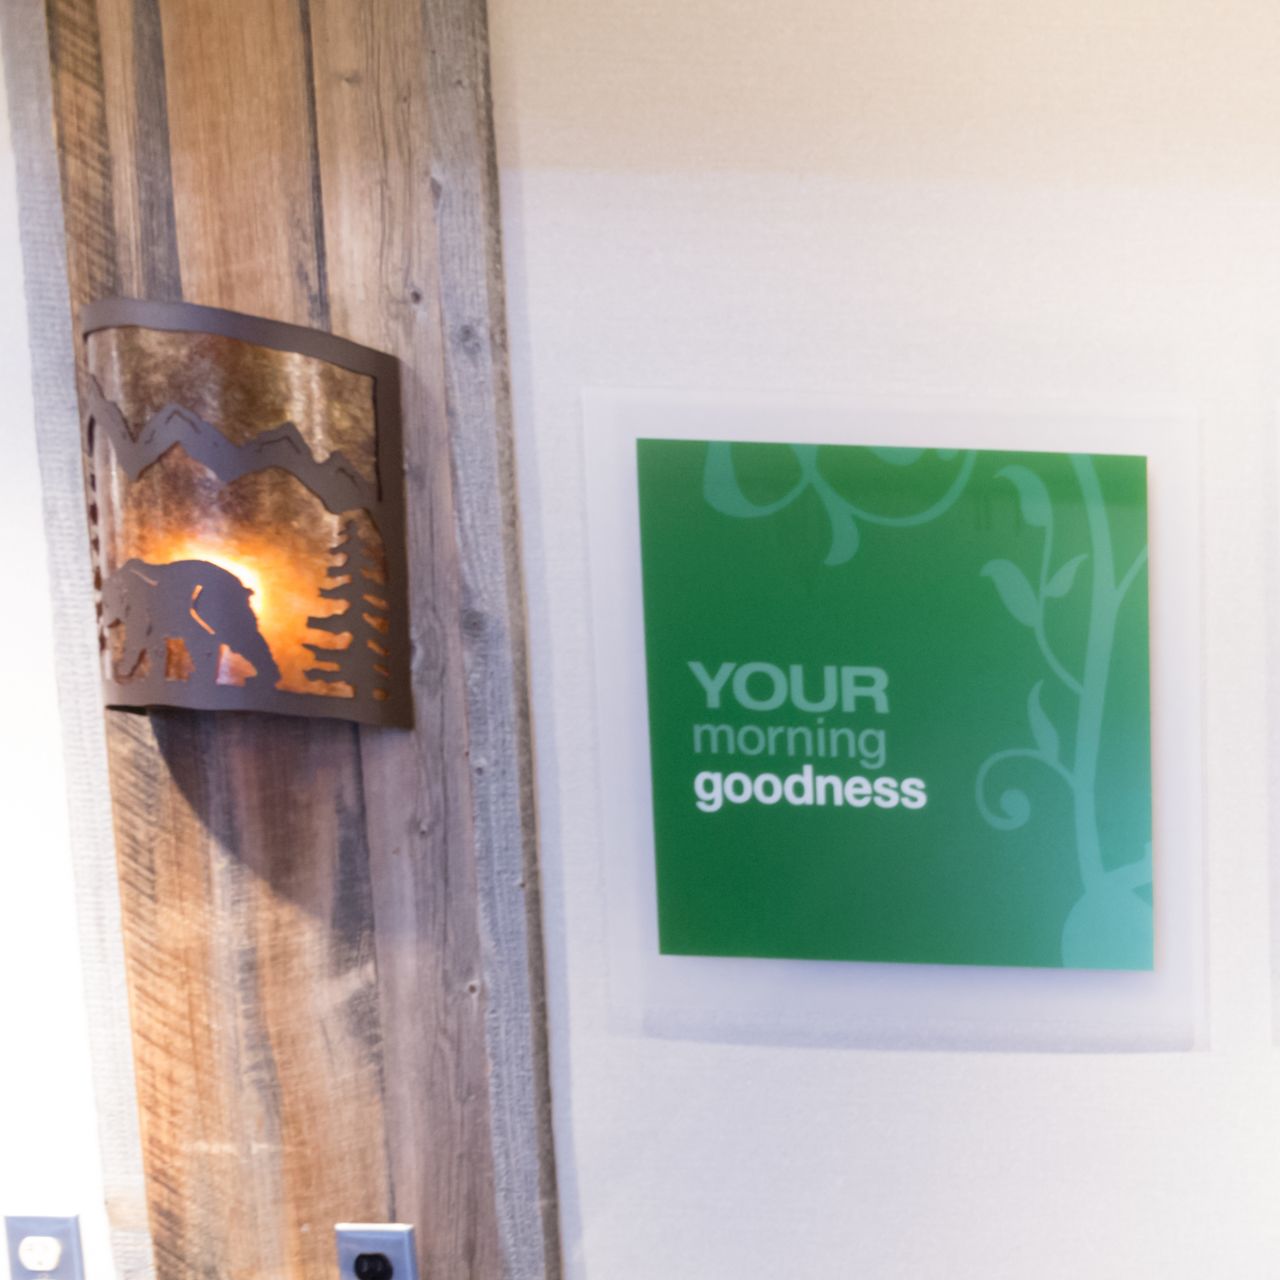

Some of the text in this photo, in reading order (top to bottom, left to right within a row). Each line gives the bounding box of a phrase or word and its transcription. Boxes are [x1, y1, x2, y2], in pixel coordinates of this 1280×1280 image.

[687, 660, 890, 714] YOUR
[693, 718, 886, 769] morning
[694, 765, 927, 812] goodness
